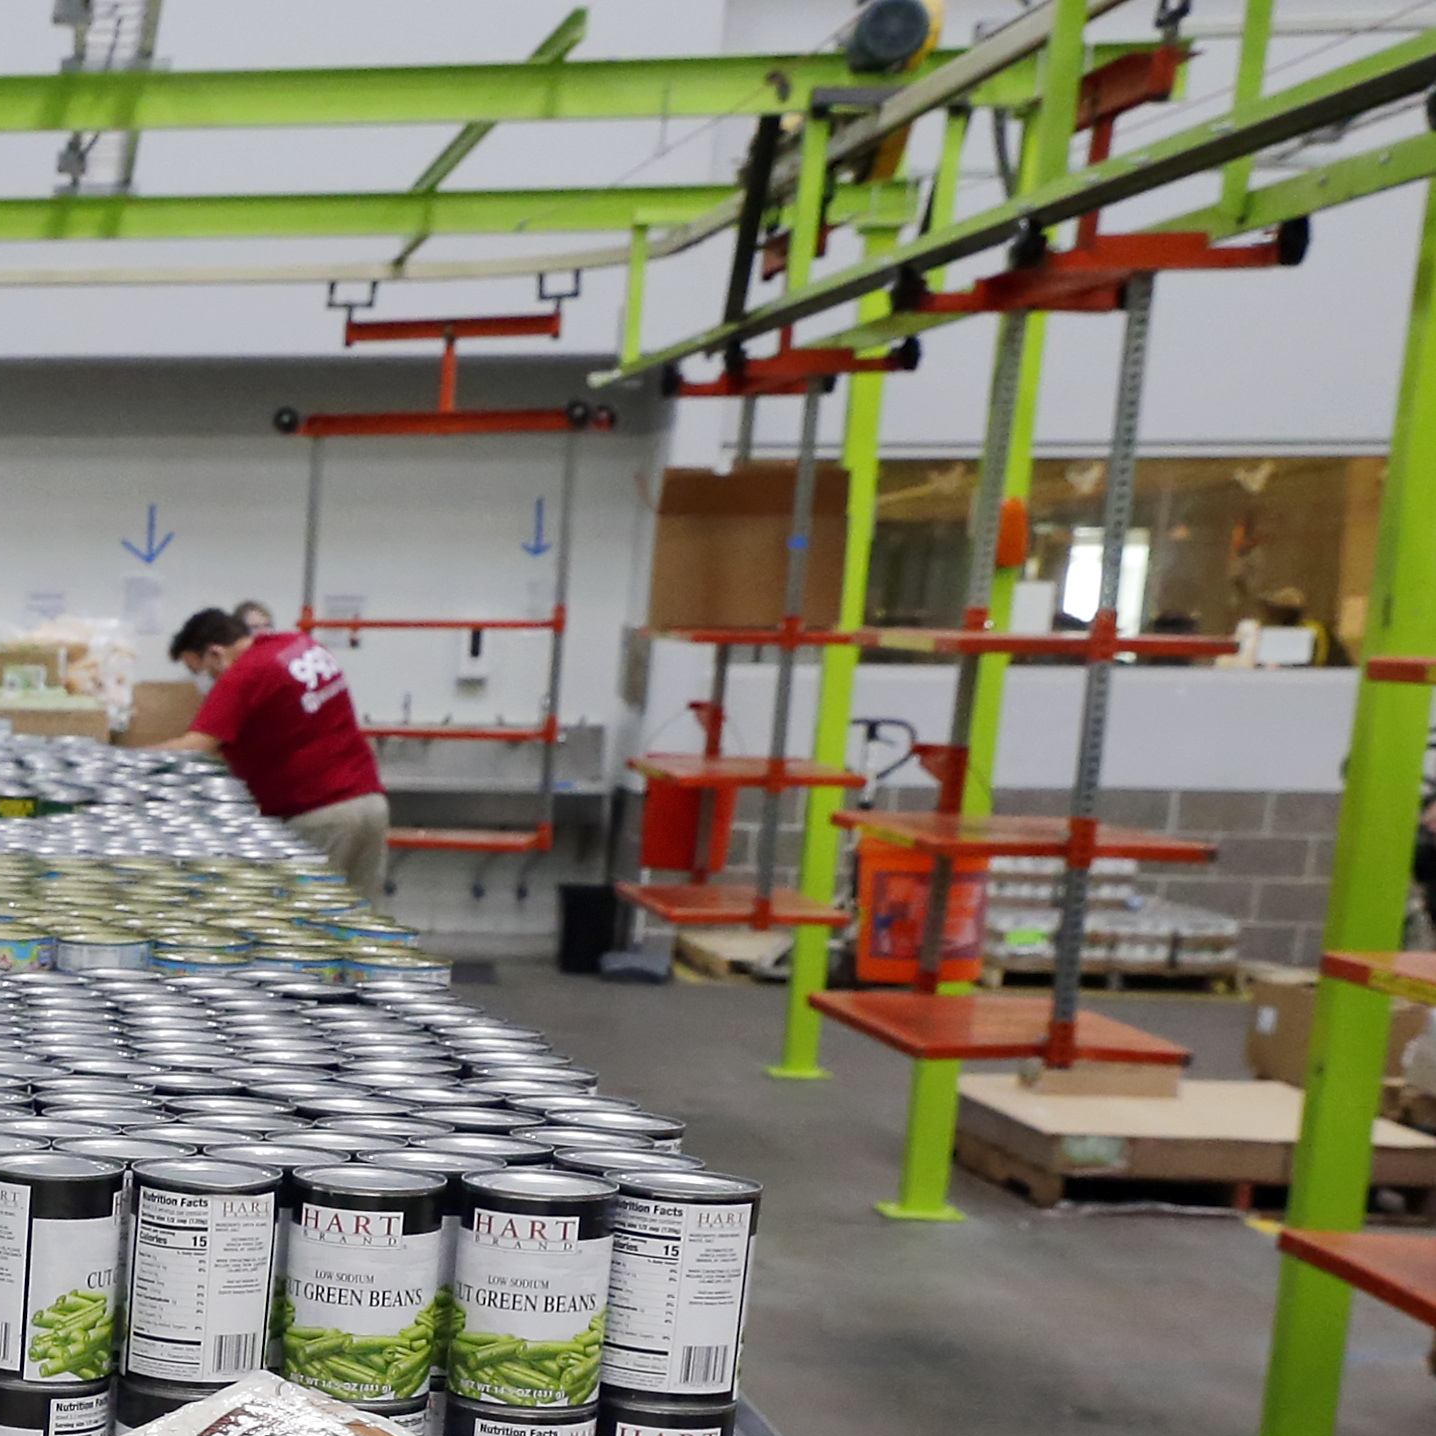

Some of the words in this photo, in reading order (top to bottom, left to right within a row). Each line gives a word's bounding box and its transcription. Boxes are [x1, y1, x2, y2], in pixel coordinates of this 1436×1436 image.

[142, 1190, 178, 1206] Nutrition
[180, 1198, 209, 1208] Facts
[222, 1200, 271, 1214] HART
[653, 1205, 684, 1217] Facts
[303, 1207, 401, 1236] HART
[697, 1211, 746, 1224] HART
[476, 1212, 577, 1241] HART
[191, 1236, 208, 1248] 15
[303, 1228, 397, 1246] BRAND
[474, 1234, 573, 1251] BRAND
[662, 1245, 680, 1257] 15
[314, 1269, 334, 1281] LOW
[335, 1272, 375, 1285] SODIUM
[487, 1275, 508, 1286] LOW
[509, 1278, 550, 1290] SODIUM
[303, 1282, 364, 1307] GREEN
[368, 1288, 423, 1309] BEANS
[475, 1288, 538, 1313] GREEN
[542, 1293, 597, 1314] BEANS
[342, 1381, 358, 1392] OZ
[516, 1387, 532, 1397] OZ
[55, 1400, 94, 1412] Nutrition
